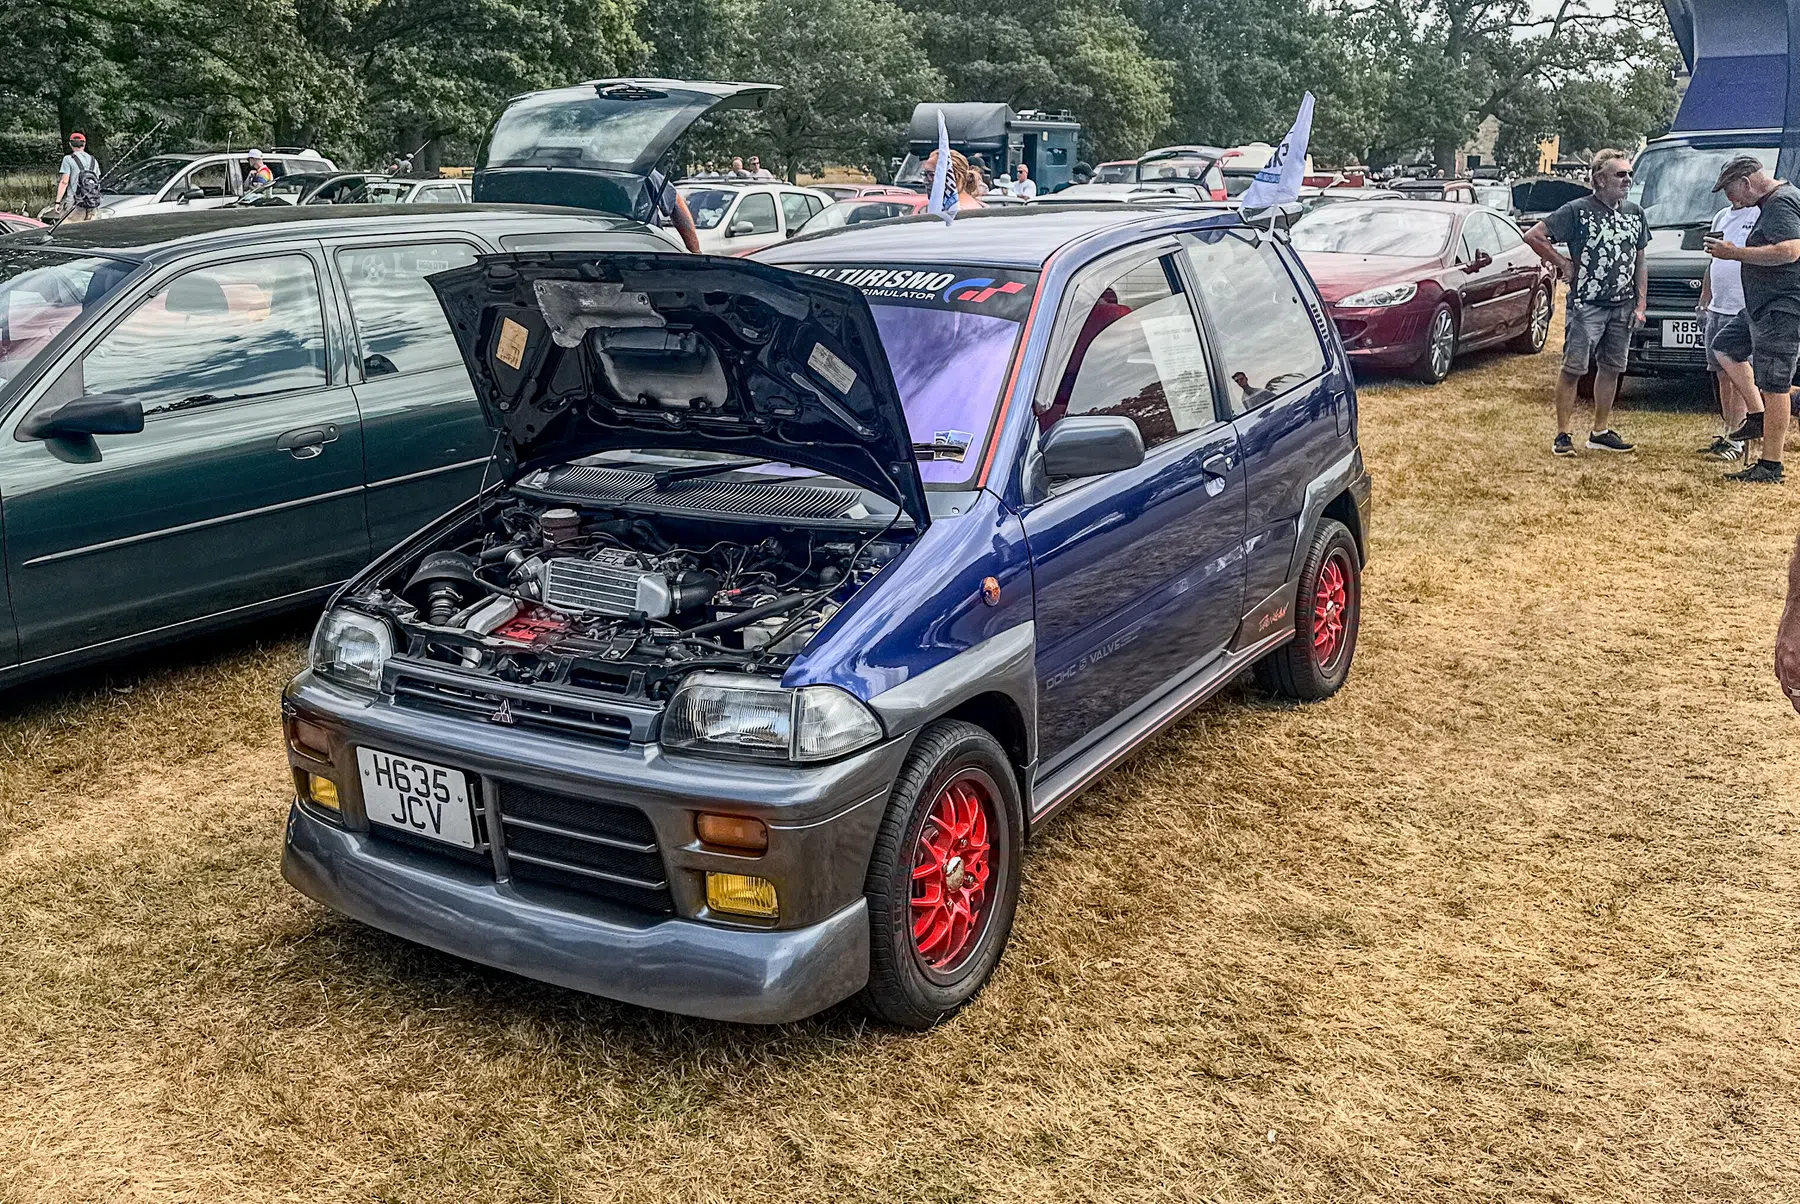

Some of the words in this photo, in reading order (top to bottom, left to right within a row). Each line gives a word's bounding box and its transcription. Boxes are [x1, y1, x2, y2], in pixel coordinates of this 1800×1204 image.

[835, 269, 955, 291] TURISMO
[862, 288, 936, 300] SIMULATOR
[1672, 321, 1704, 333] R89
[1046, 664, 1076, 691] DOHC
[373, 753, 450, 804] H635
[391, 793, 442, 835] JCV
